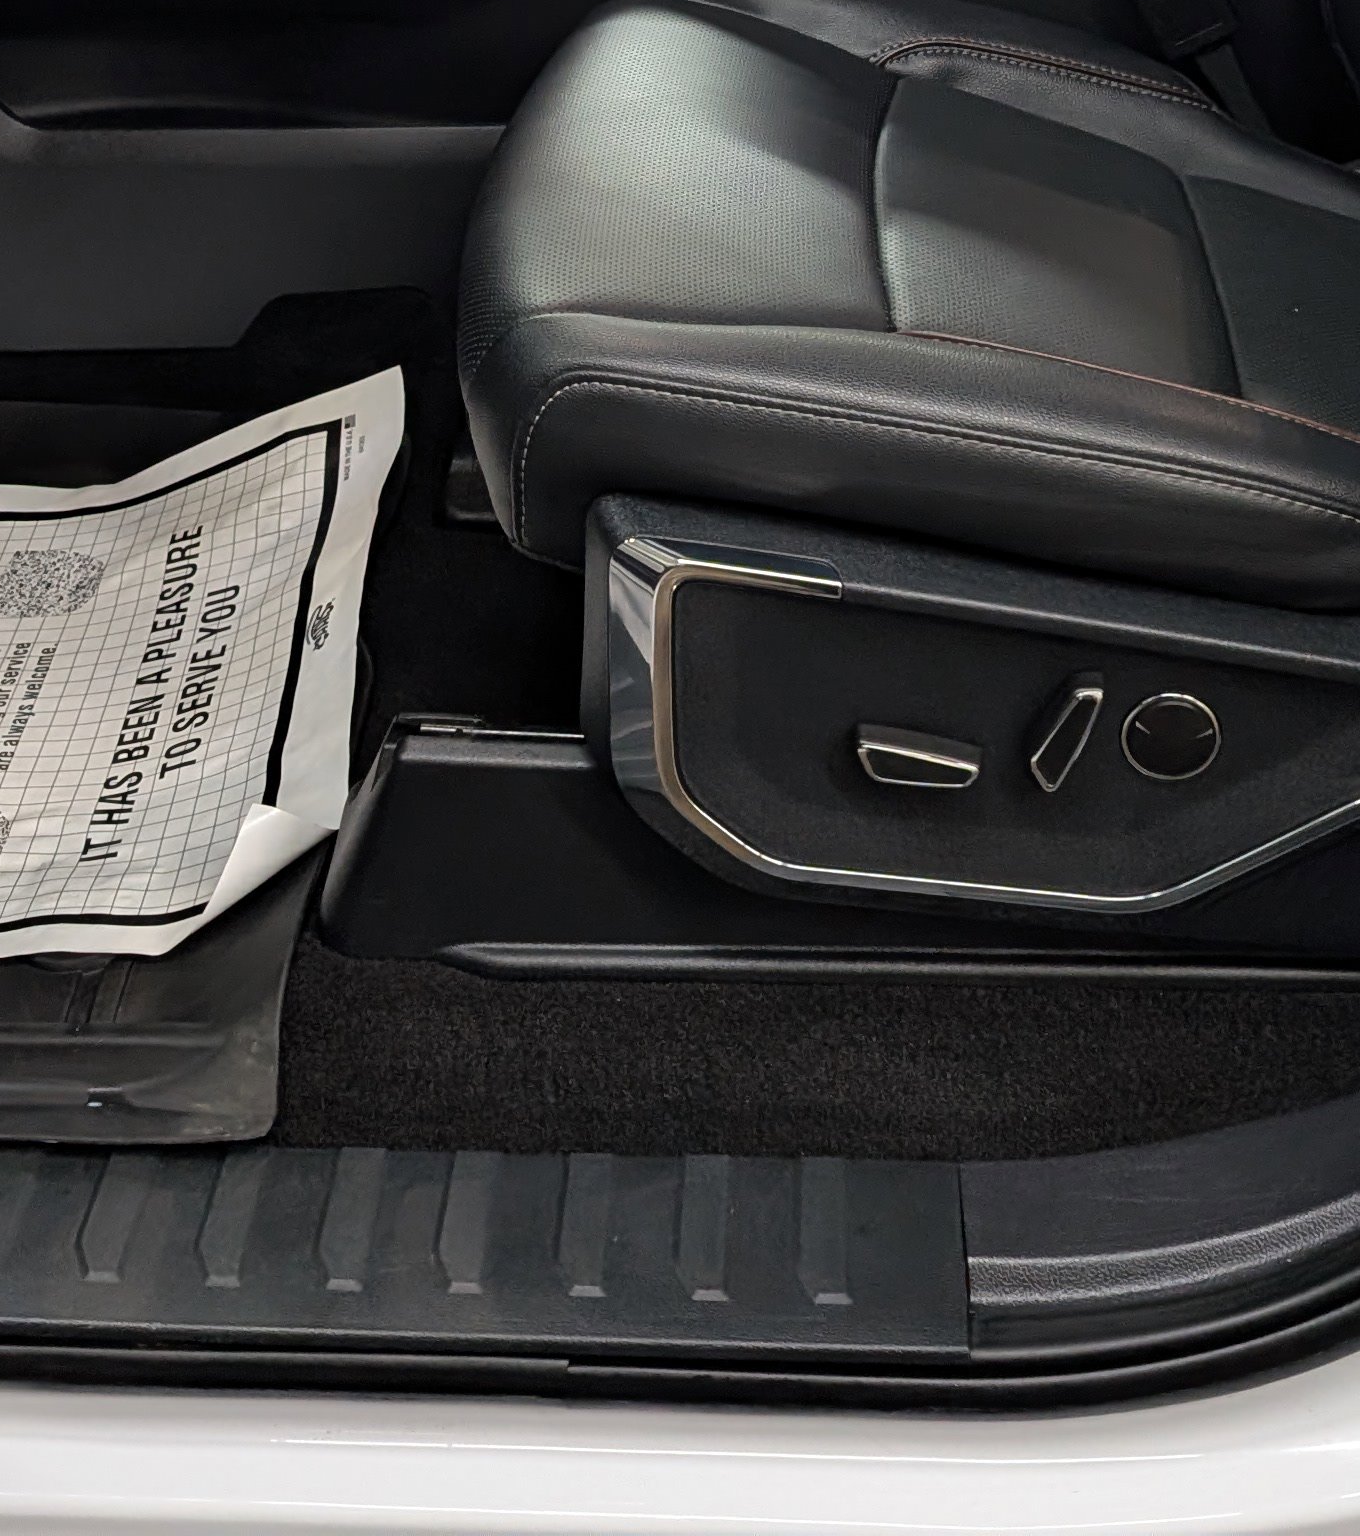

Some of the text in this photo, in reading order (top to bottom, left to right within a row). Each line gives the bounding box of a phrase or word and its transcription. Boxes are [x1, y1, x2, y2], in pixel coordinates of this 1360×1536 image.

[0, 642, 31, 685] service
[1, 704, 35, 747] always
[22, 643, 58, 701] welcome.
[79, 525, 203, 863] IT HAS BEEN A PLEASURE
[159, 584, 241, 780] TO SERVE YOU
